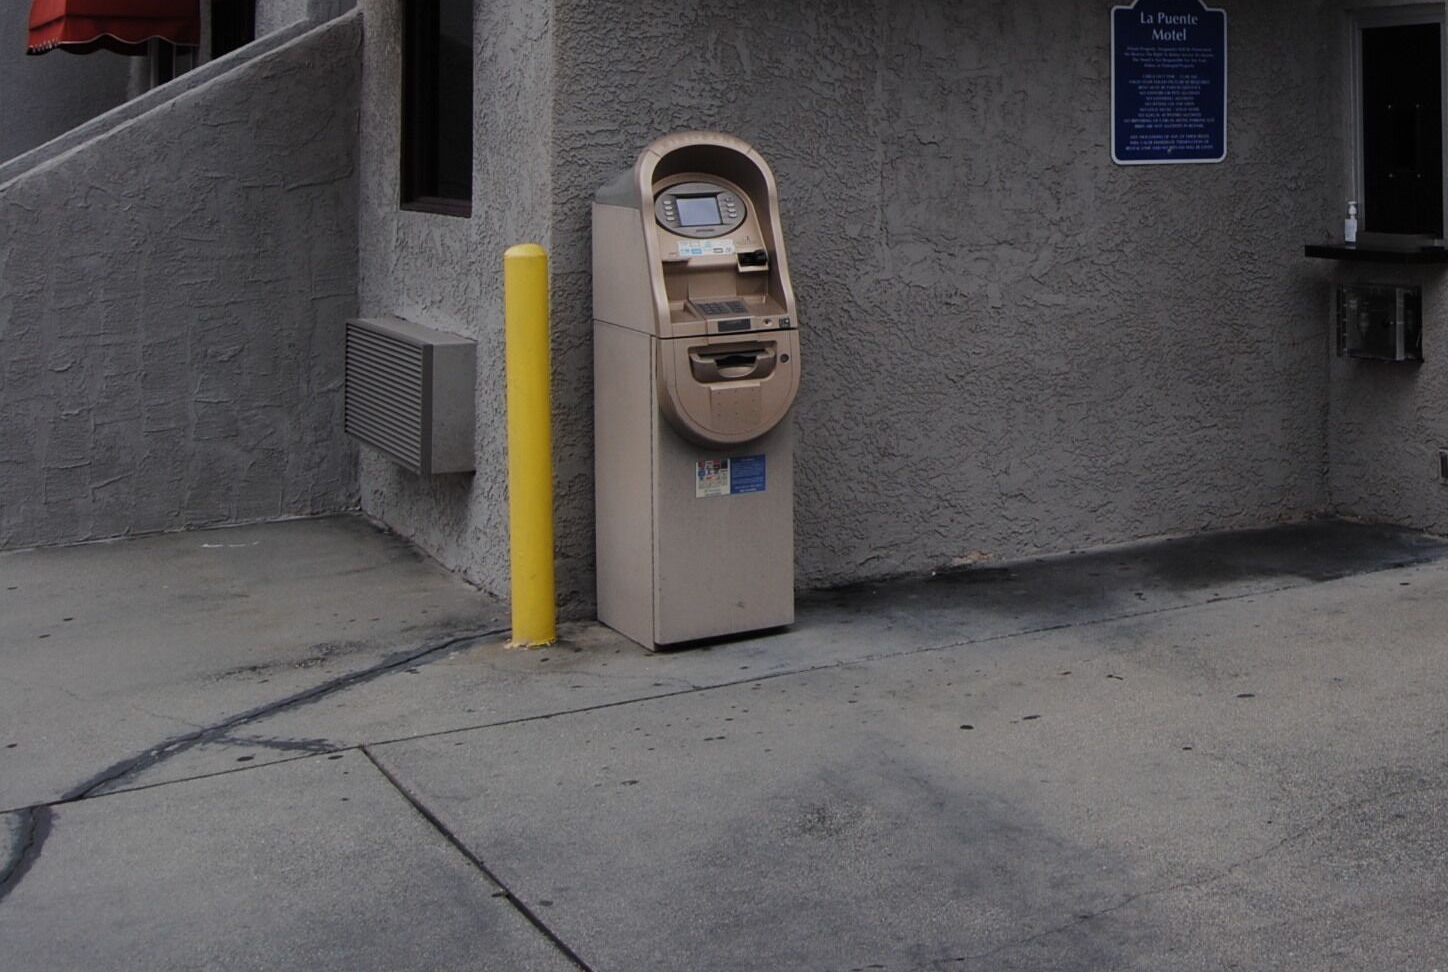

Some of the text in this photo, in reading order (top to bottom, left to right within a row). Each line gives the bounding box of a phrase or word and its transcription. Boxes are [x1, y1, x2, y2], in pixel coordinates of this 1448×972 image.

[1140, 11, 1199, 26] La Puente
[1151, 27, 1187, 42] Motel
